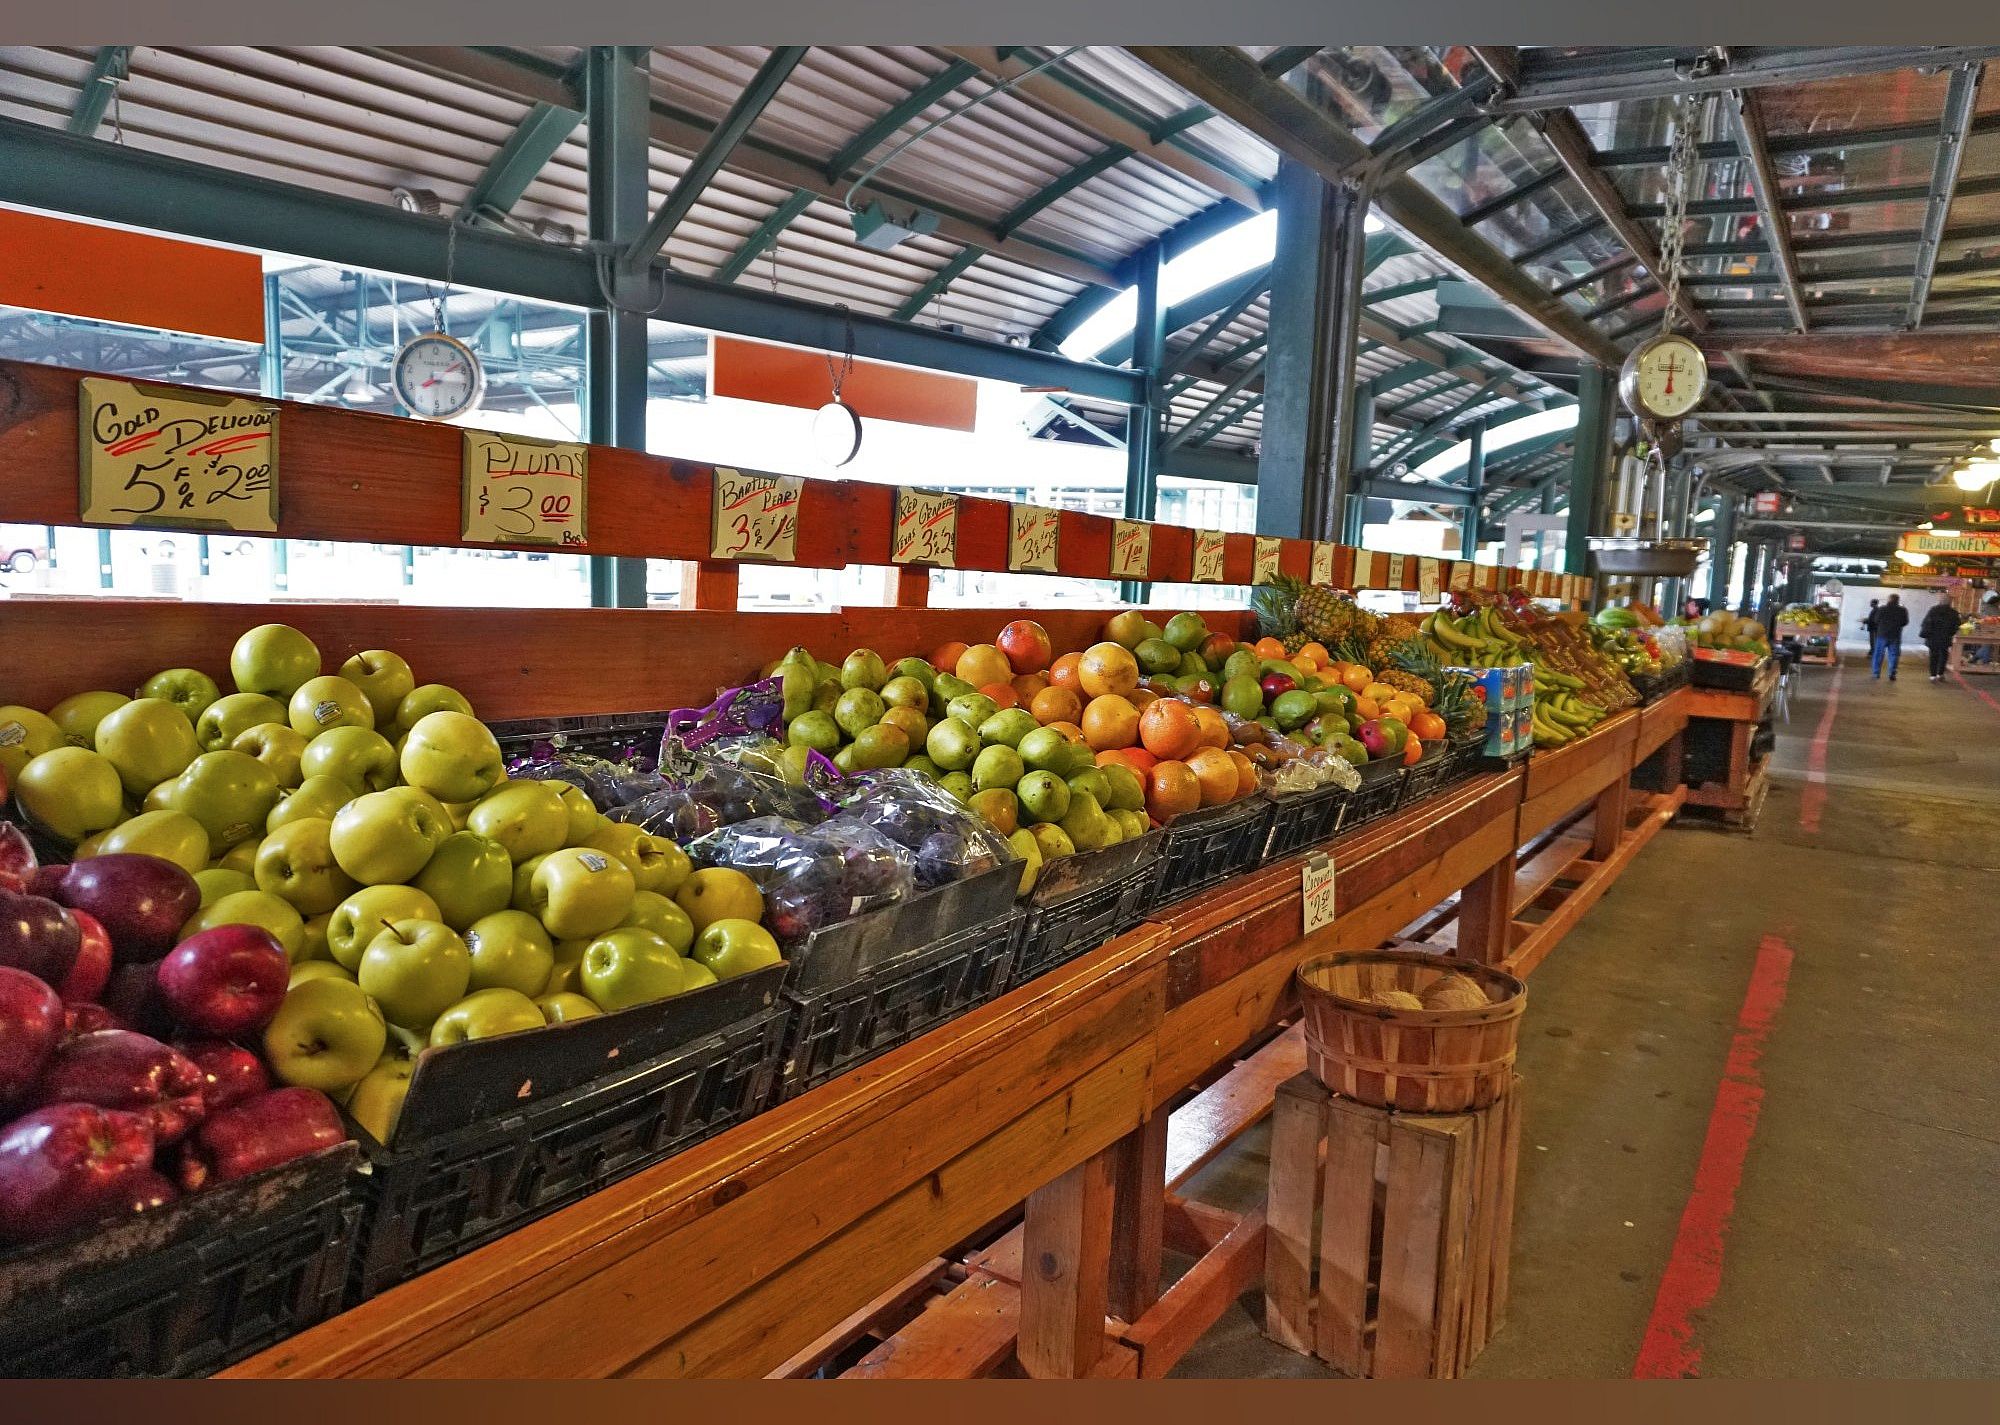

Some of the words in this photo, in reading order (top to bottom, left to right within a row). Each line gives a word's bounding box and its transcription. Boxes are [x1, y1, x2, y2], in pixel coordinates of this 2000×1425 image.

[93, 402, 160, 444] GOLD
[110, 457, 175, 513] 5
[173, 466, 195, 509] FOR
[763, 488, 798, 512] PEARS
[900, 495, 918, 521] RED
[918, 498, 957, 525] GRAPEFR
[726, 513, 751, 554] 3
[752, 517, 763, 548] FOR
[911, 528, 933, 561] 3
[1919, 536, 1988, 551] DRAGONFLY
[1020, 538, 1034, 571] 3
[1196, 555, 1208, 579] 3
